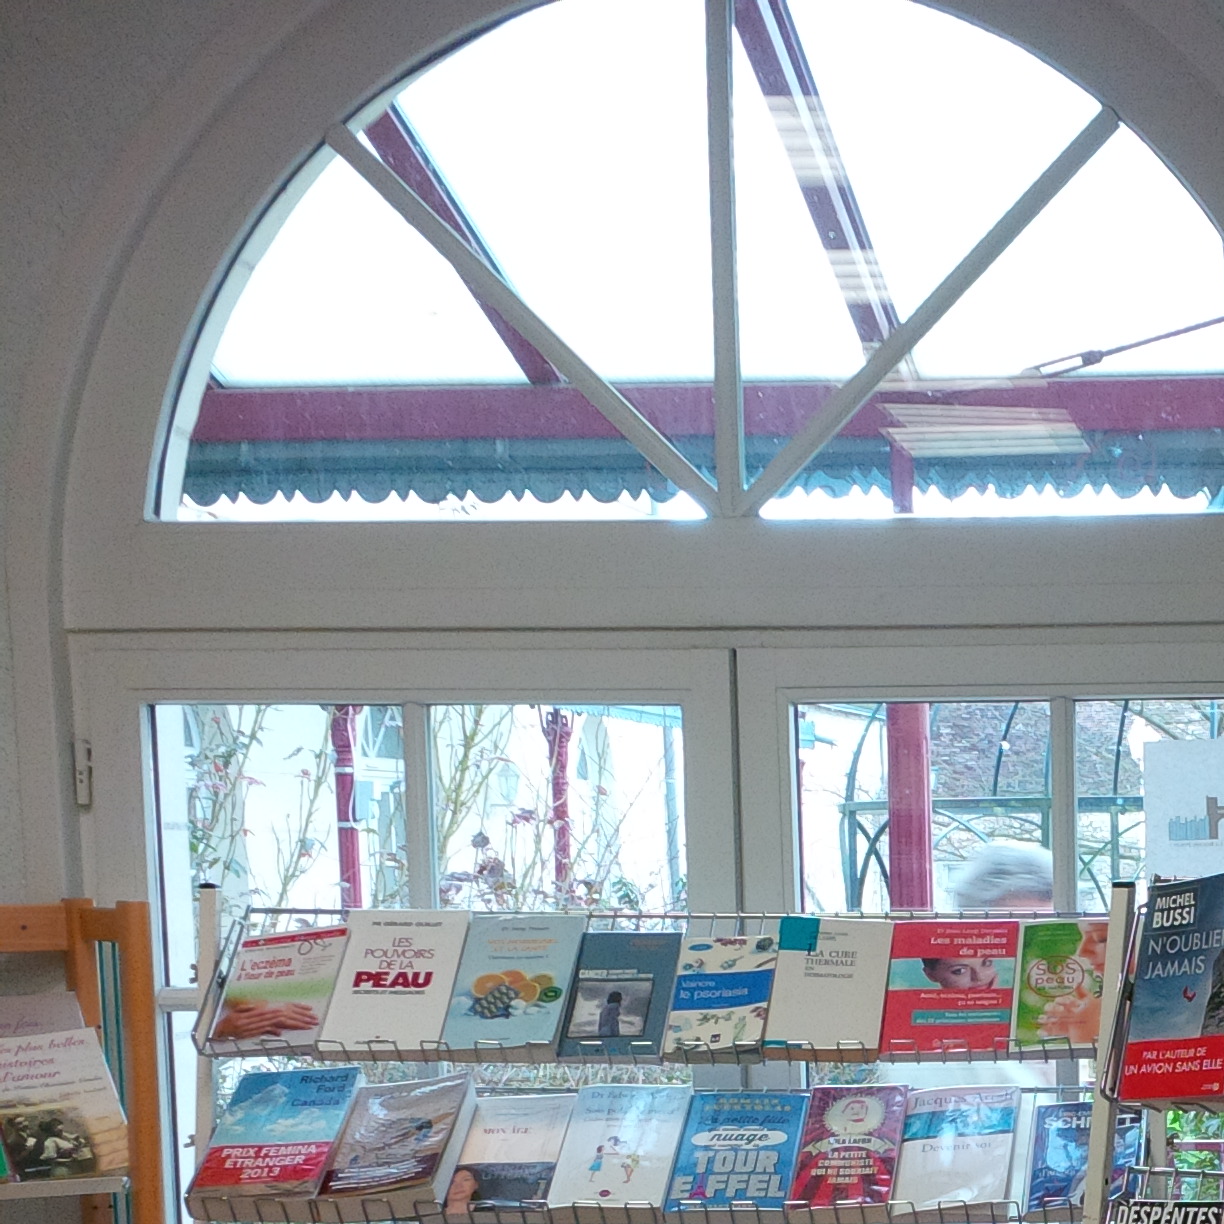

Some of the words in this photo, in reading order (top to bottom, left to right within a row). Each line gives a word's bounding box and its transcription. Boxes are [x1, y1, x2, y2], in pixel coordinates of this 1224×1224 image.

[1155, 892, 1195, 910] MICHEL
[1152, 909, 1194, 928] BUSSI
[390, 937, 412, 948] LES
[931, 936, 948, 945] Les
[951, 936, 1007, 945] maladies
[363, 948, 434, 960] POUVOIRS
[959, 946, 974, 956] de
[977, 947, 1006, 957] peau
[379, 959, 397, 970] DE
[1144, 956, 1205, 980] JAMAIS
[352, 971, 434, 989] PEAU
[1142, 1048, 1157, 1059] PAR
[1159, 1046, 1193, 1058] L'AUTEUR
[1196, 1045, 1206, 1056] DE
[1124, 1063, 1137, 1076] UN
[1140, 1061, 1173, 1074] AVION
[1175, 1060, 1200, 1072] SANS
[1202, 1058, 1223, 1070] ELLE
[709, 1134, 769, 1145] nuage
[222, 1147, 257, 1158] PRIX
[261, 1144, 318, 1156] FEMINA
[224, 1155, 304, 1169] ETRANGER
[694, 1151, 778, 1173] TOUR
[240, 1167, 280, 1180] 2013
